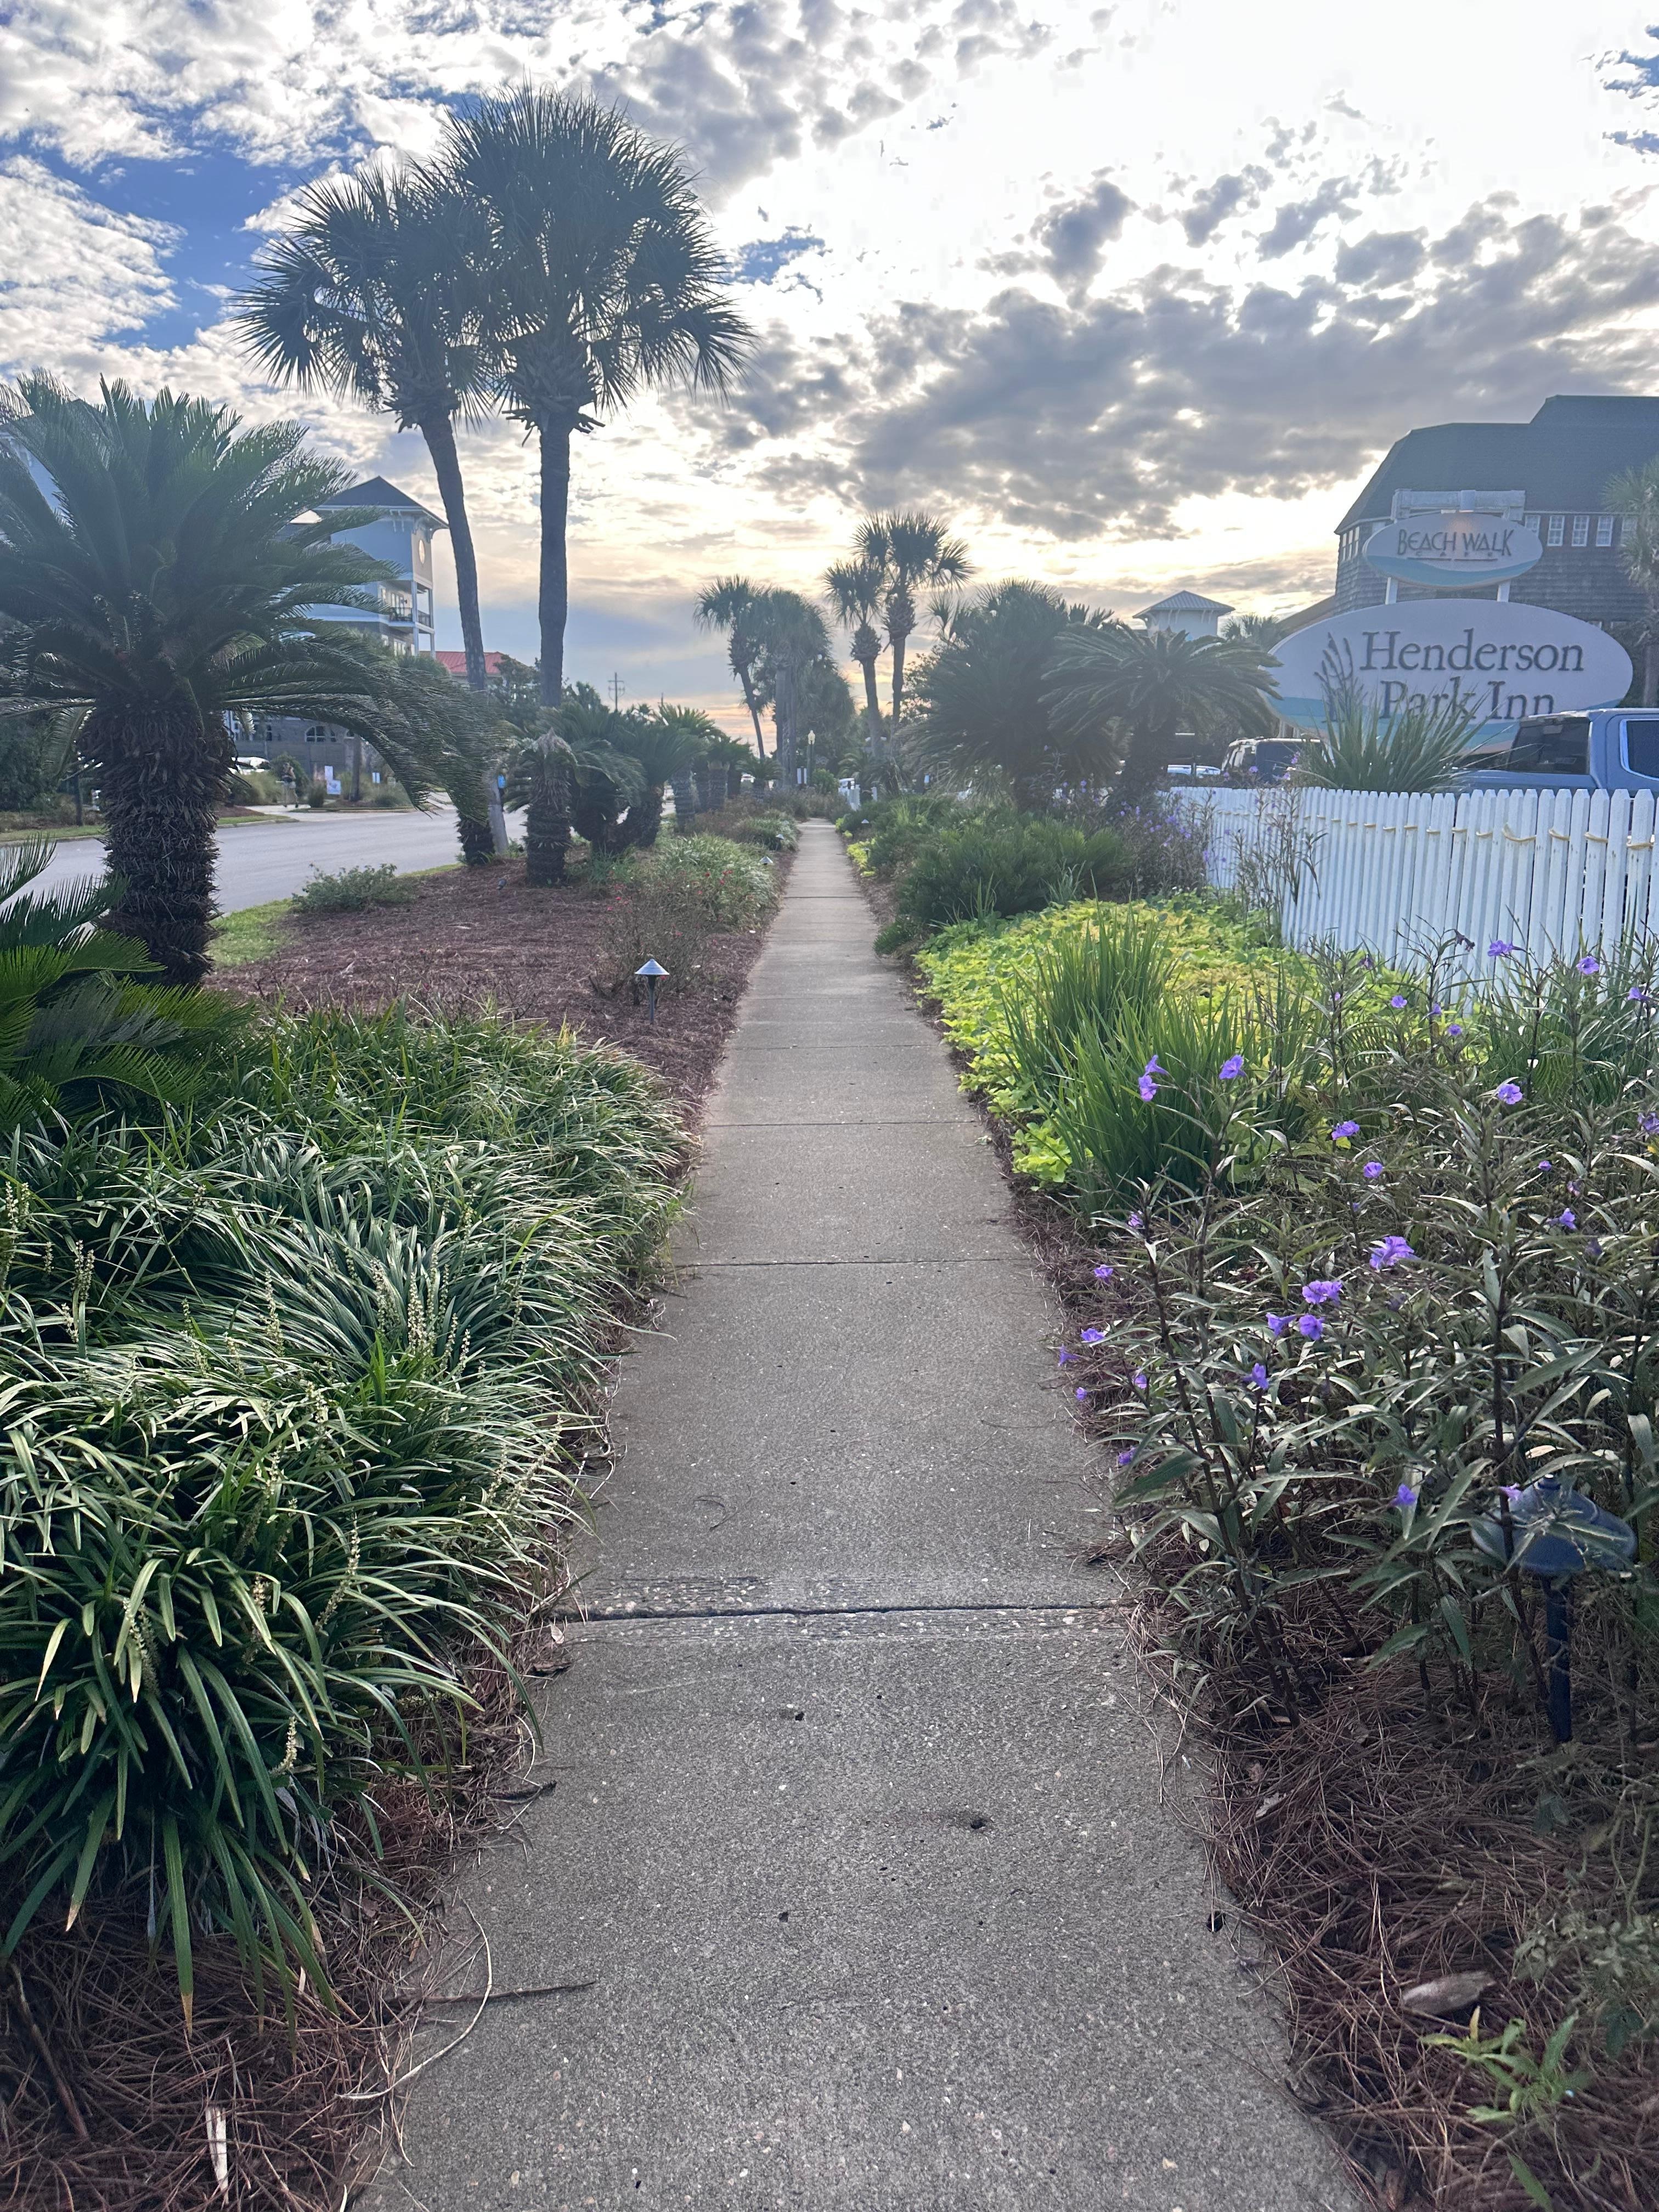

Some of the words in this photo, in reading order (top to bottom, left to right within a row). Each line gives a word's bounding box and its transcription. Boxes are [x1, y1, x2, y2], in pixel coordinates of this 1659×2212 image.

[1397, 529, 1457, 555] BEACH
[1463, 529, 1514, 556] WALK
[1359, 628, 1584, 670] Henderson
[1379, 676, 1476, 719] Park
[1487, 681, 1554, 720] Inn
